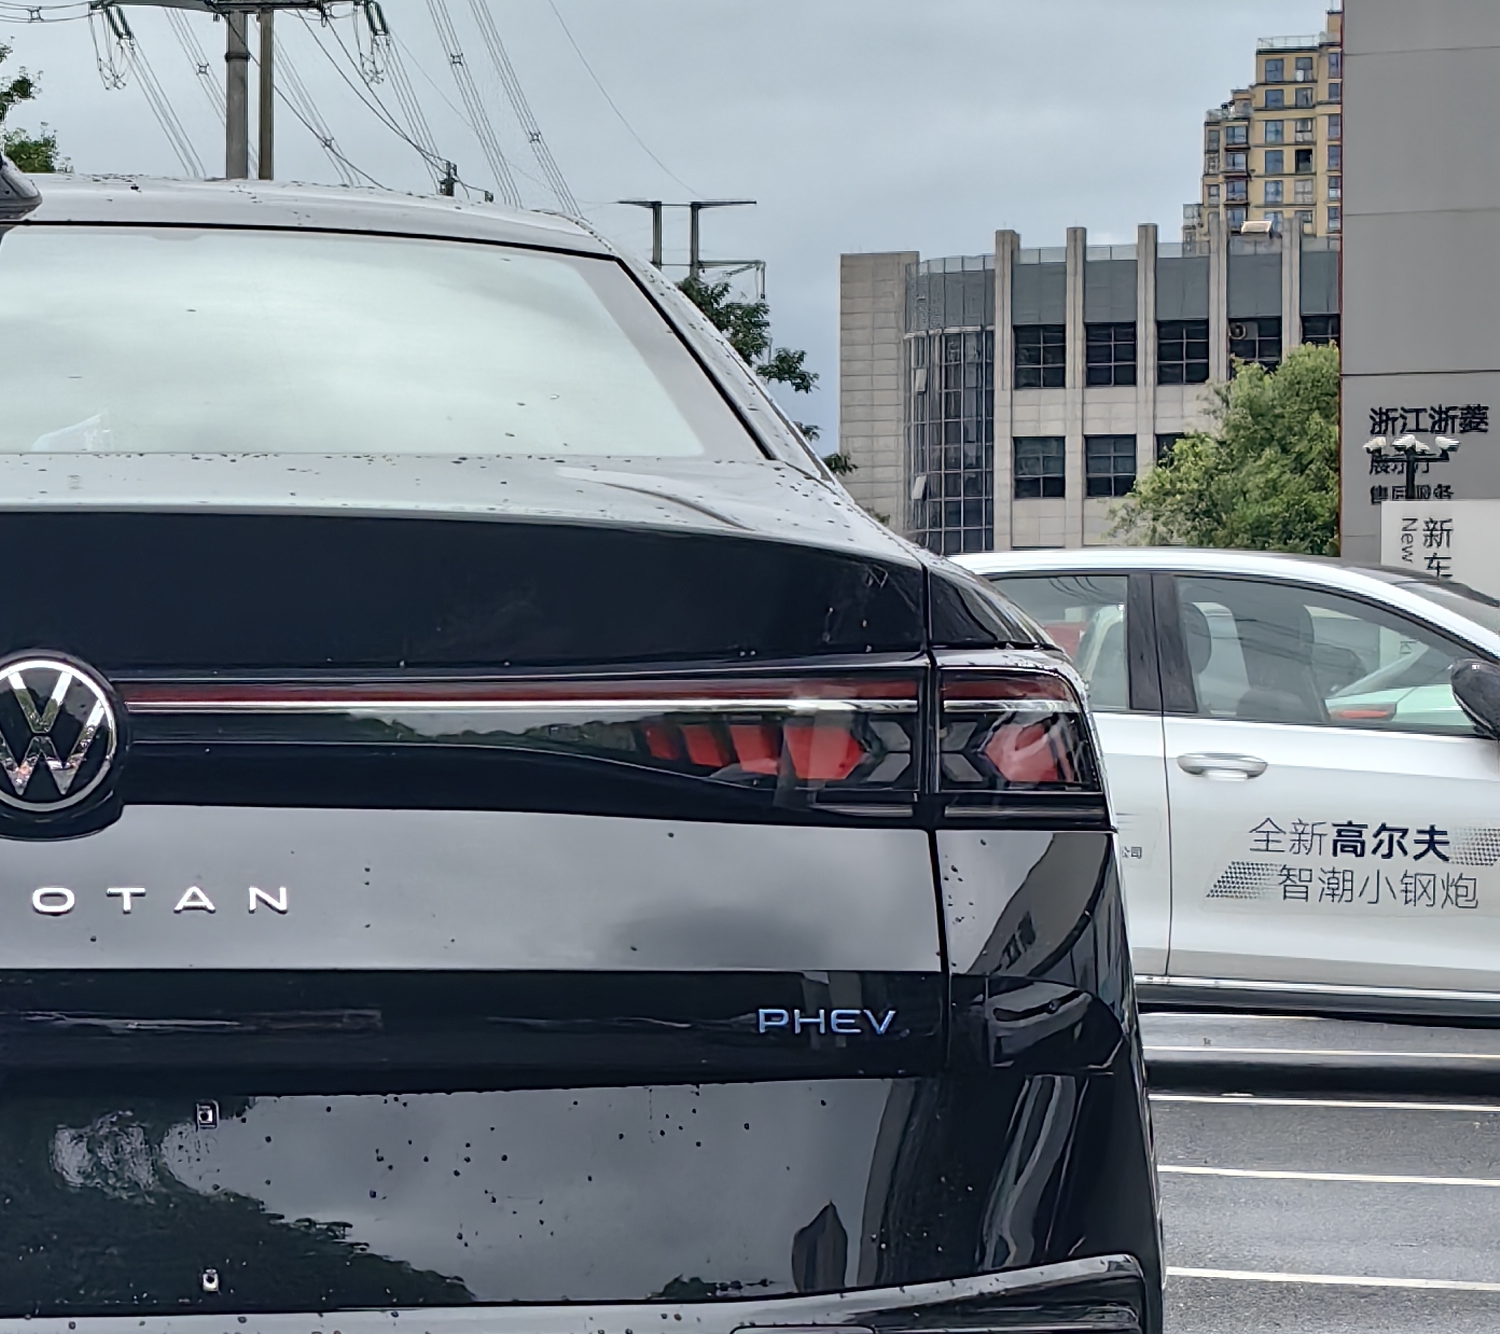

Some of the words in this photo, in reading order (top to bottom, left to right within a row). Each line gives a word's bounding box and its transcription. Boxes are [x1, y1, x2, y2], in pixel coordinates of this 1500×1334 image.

[1400, 517, 1419, 563] New
[1249, 817, 1451, 862] 全新高尔夫
[1278, 864, 1479, 910] 智潮小钢炮
[758, 1008, 897, 1035] PHEV
